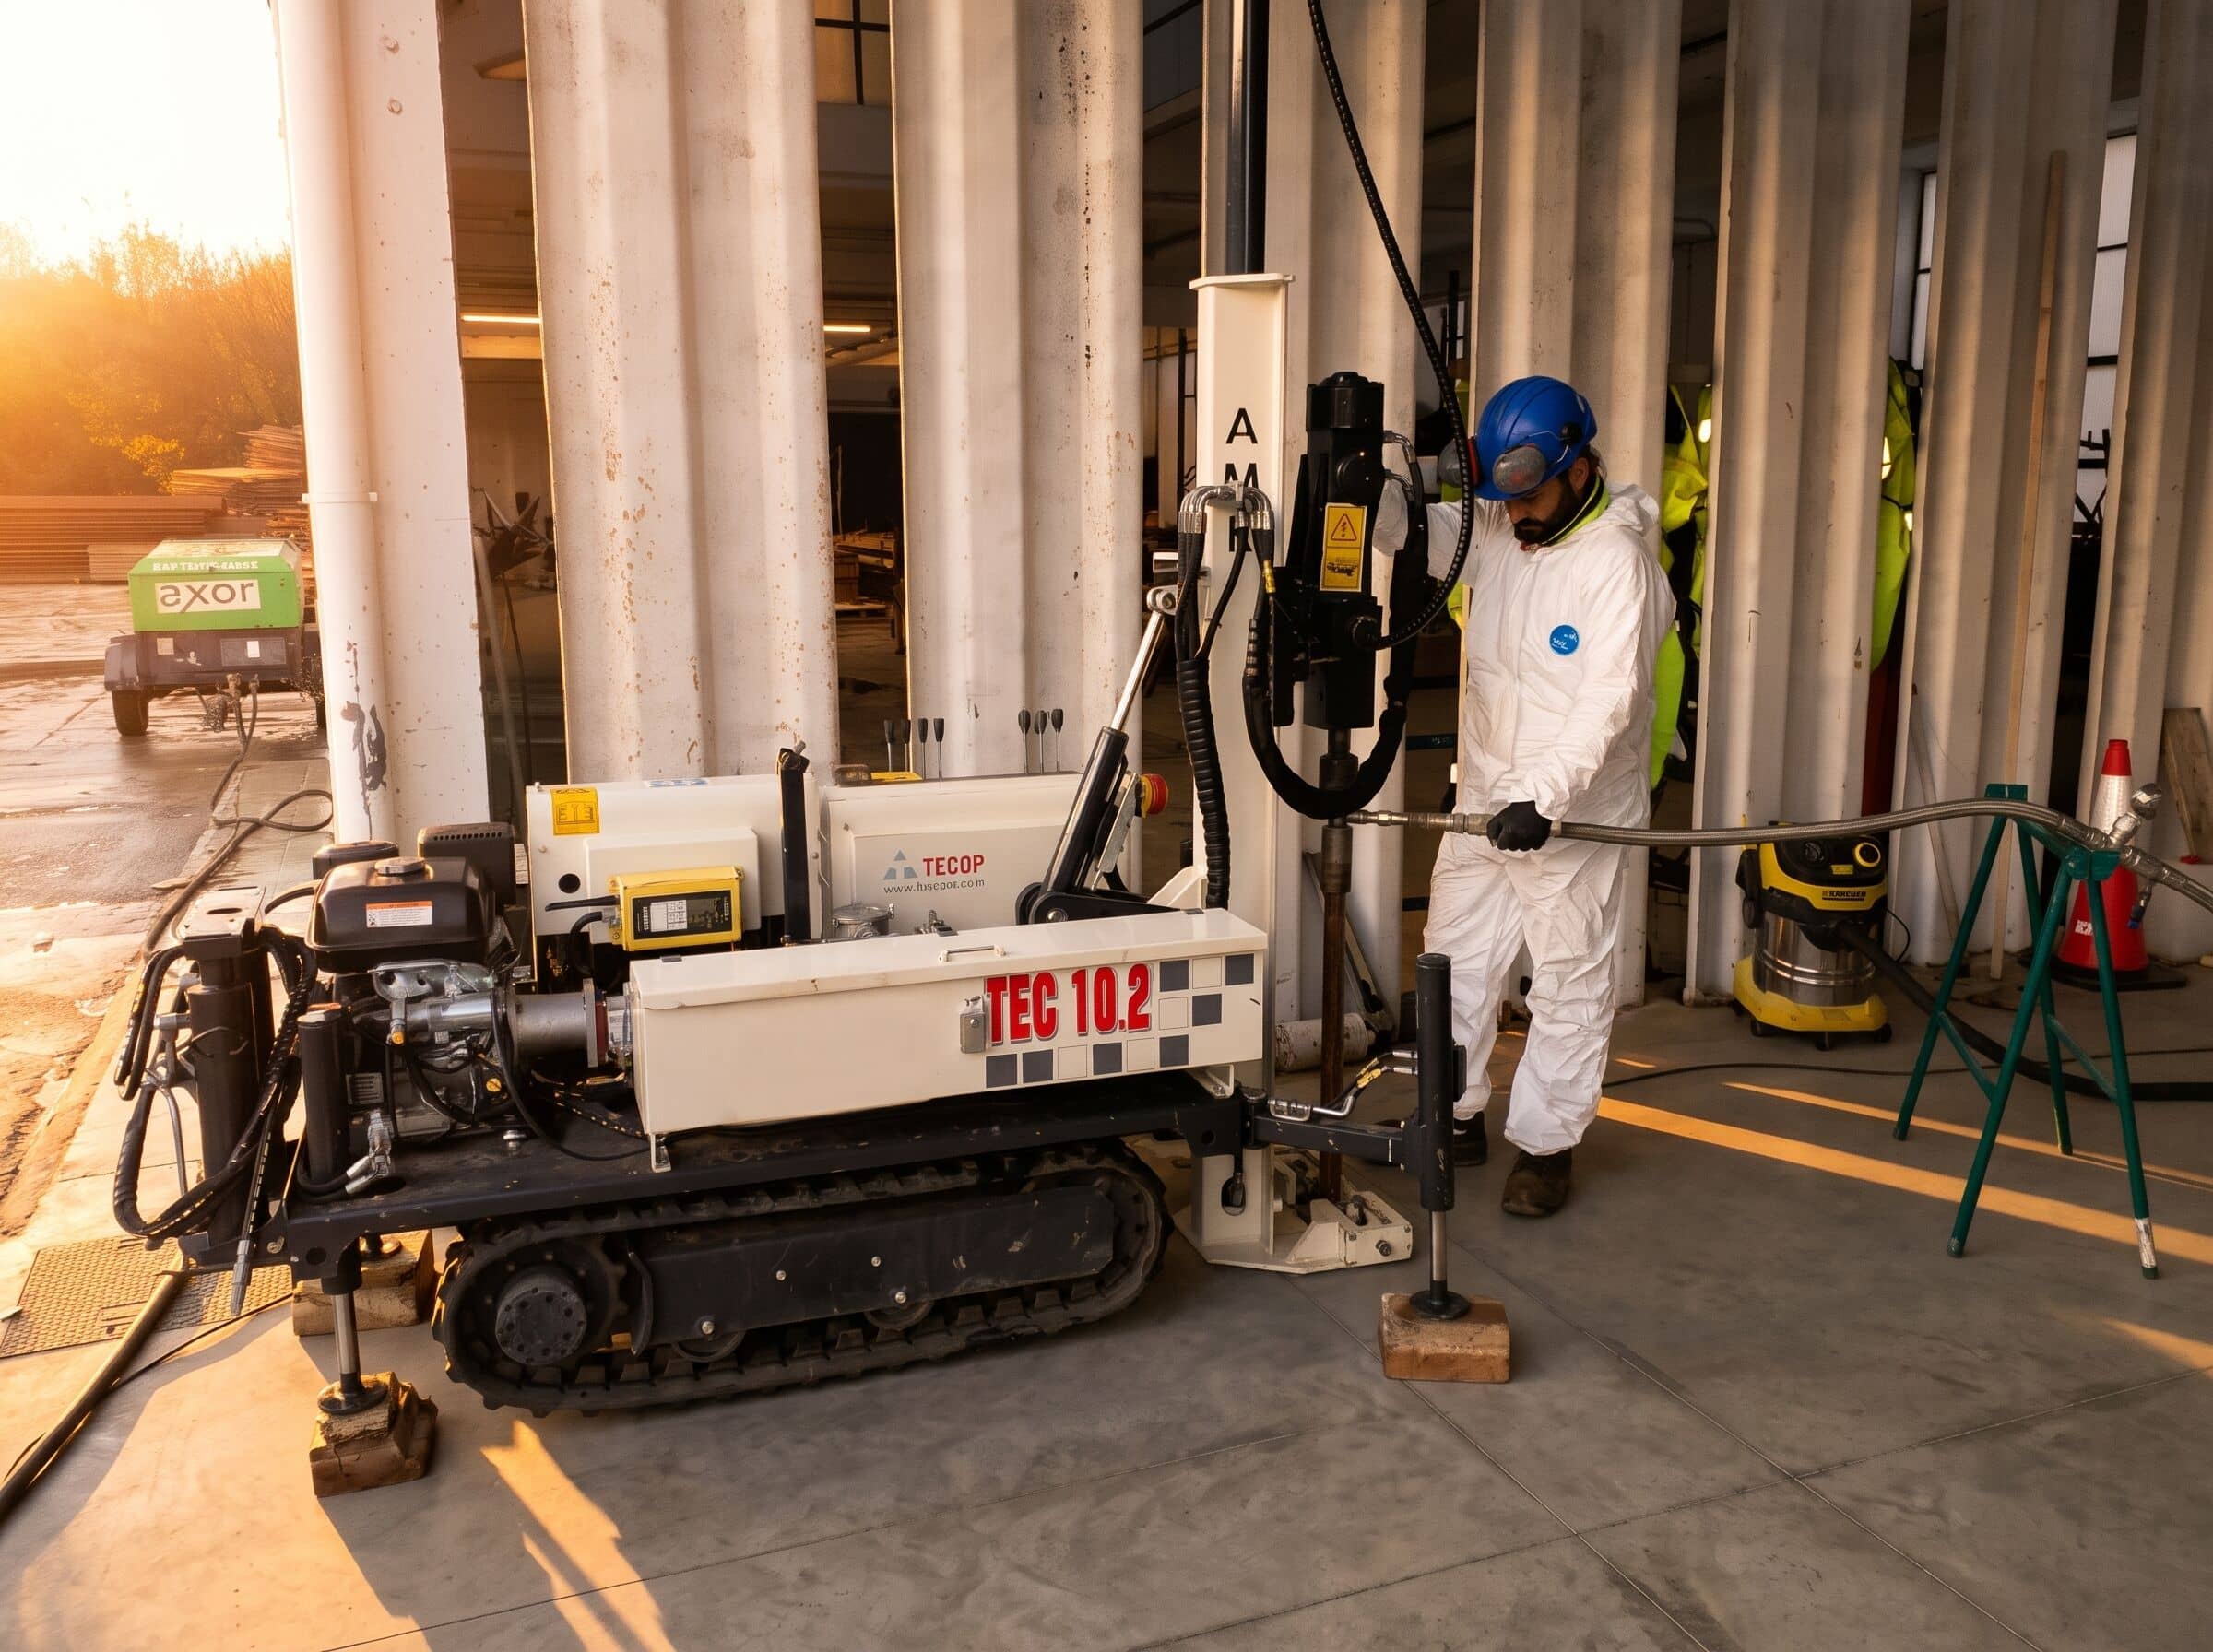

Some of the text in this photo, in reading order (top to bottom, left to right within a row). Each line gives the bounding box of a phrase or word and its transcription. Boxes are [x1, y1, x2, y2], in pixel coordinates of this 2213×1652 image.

[922, 855, 985, 876] TECOP
[986, 963, 1152, 1044] TEC 10.2
